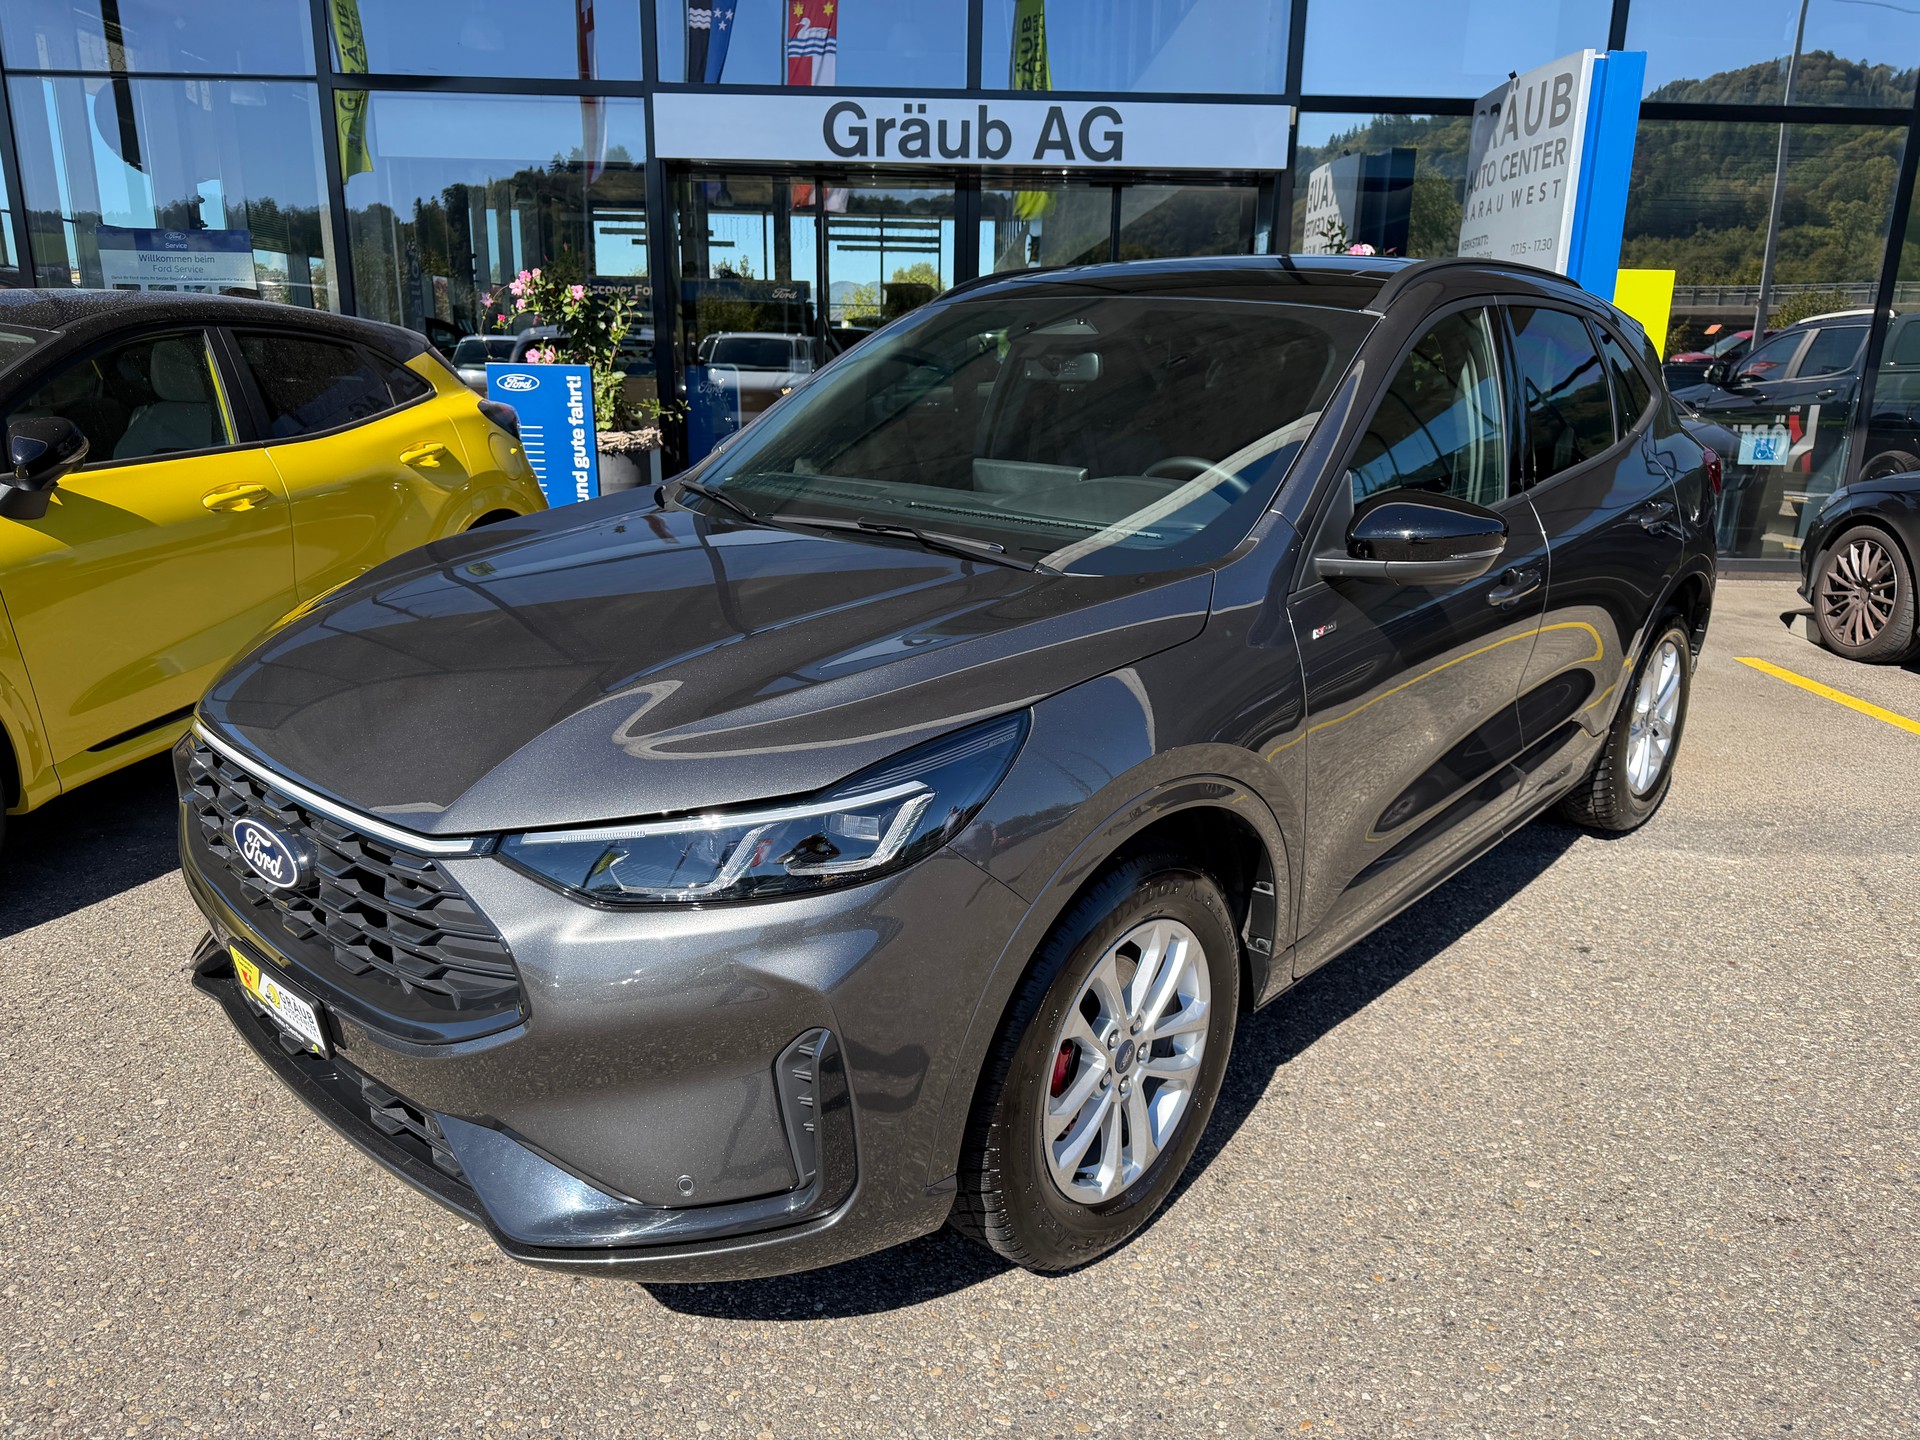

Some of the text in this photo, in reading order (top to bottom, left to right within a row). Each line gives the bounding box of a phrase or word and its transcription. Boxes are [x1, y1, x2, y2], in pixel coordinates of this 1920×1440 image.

[337, 4, 362, 112] GÄUB
[823, 101, 1124, 162] Gräub AG
[1466, 137, 1567, 195] AUTO CENTER
[1463, 179, 1562, 223] AARAU WEST
[138, 254, 215, 263] Willkommen beim
[1533, 238, 1553, 252] 17.30
[152, 265, 204, 274] Ford Service
[771, 288, 798, 299] Ford
[502, 375, 535, 390] Ford
[566, 375, 590, 503] und gute fahrt!
[242, 826, 286, 881] Ford
